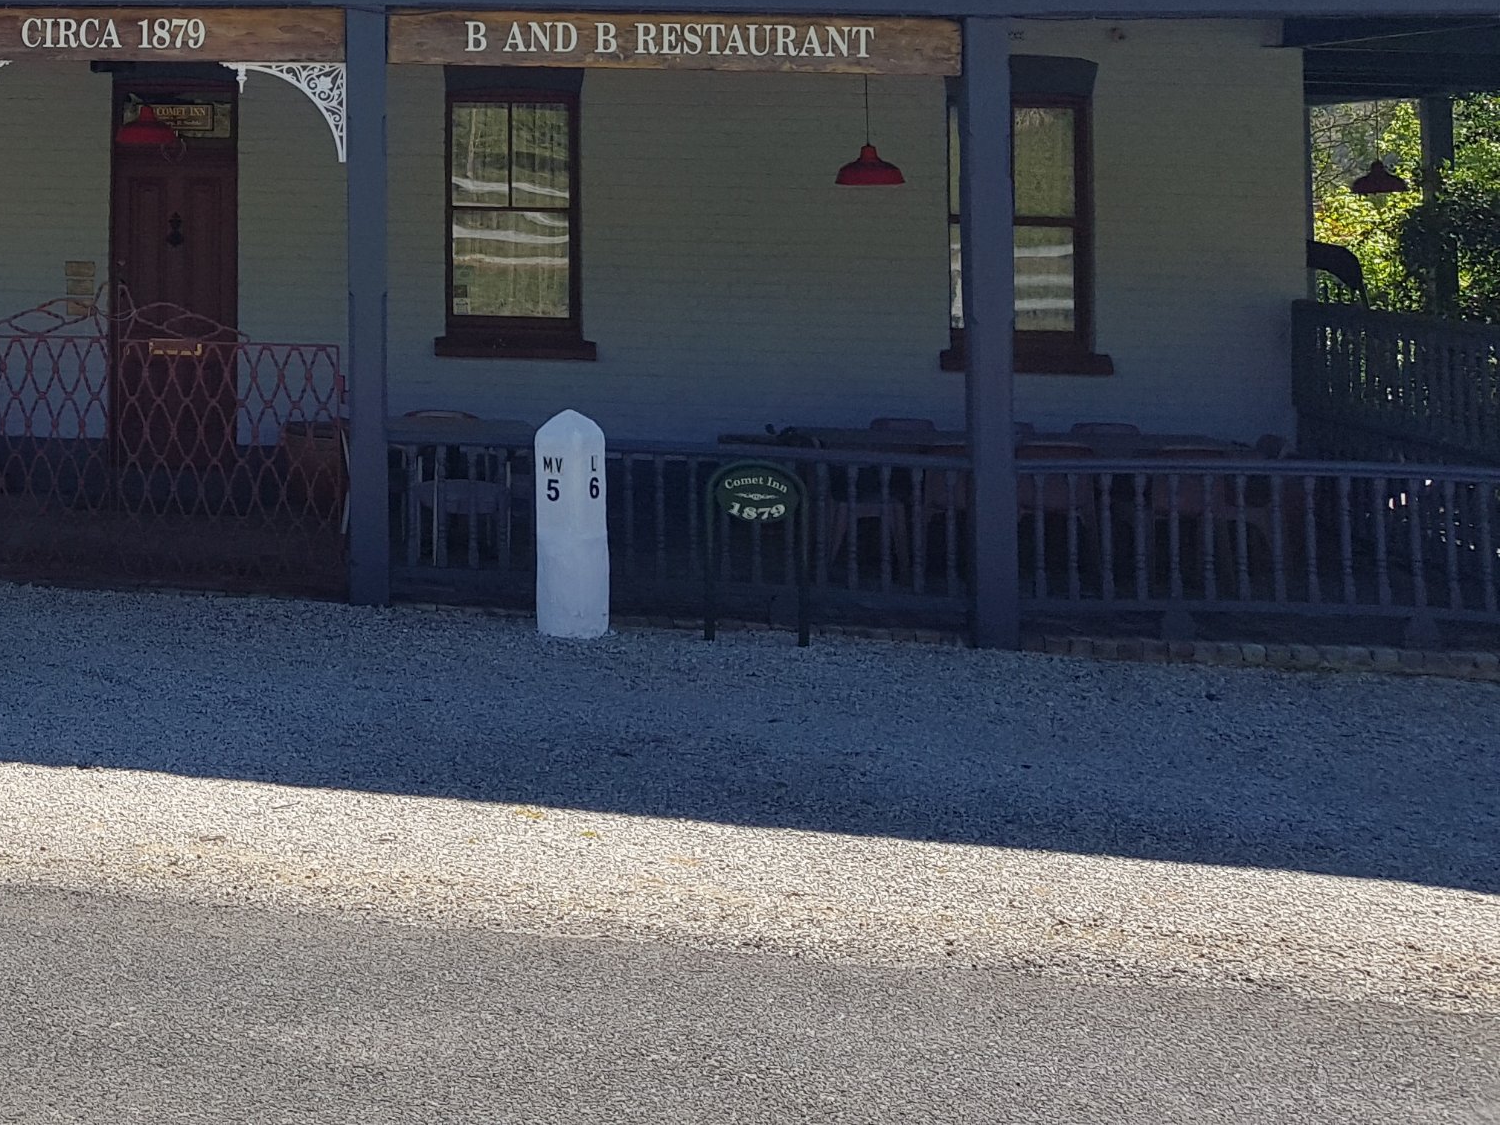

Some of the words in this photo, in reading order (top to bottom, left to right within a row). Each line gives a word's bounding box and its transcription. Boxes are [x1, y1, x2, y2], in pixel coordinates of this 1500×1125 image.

[21, 17, 123, 49] CIRCA
[137, 18, 207, 49] 1879
[464, 21, 488, 52] B
[502, 21, 578, 53] AND
[594, 22, 618, 54] B
[634, 22, 876, 58] RESTAURANT
[546, 478, 560, 502] 5
[589, 477, 600, 499] 6
[724, 476, 763, 490] Comet
[767, 476, 788, 493] Inn
[728, 502, 786, 521] 1879
